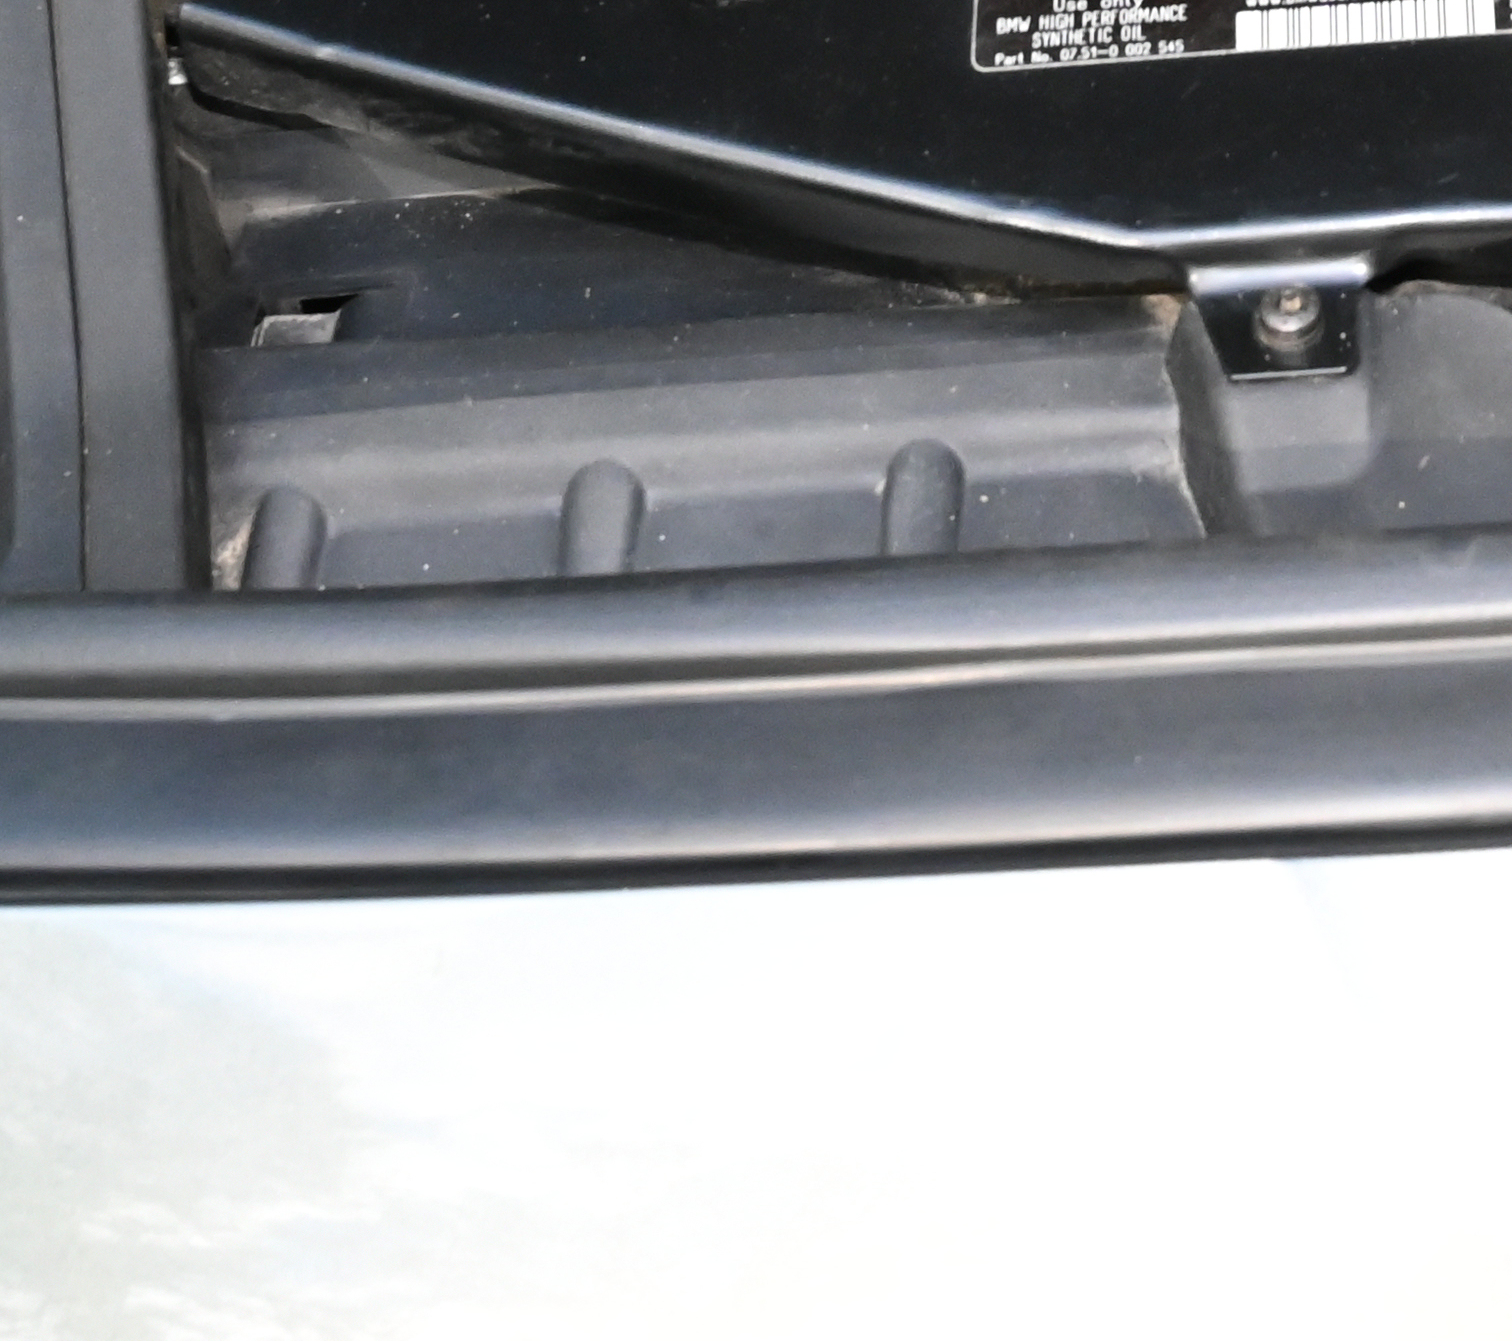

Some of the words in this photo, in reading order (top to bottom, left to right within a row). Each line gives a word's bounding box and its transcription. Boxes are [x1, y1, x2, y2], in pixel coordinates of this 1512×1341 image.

[996, 16, 1031, 35] BMW
[1038, 13, 1075, 30] HIGH
[1081, 3, 1188, 27] PERFORMANCE
[1031, 26, 1114, 49] SYNTHETIC
[1120, 25, 1147, 42] OIL
[994, 52, 1024, 66] Part
